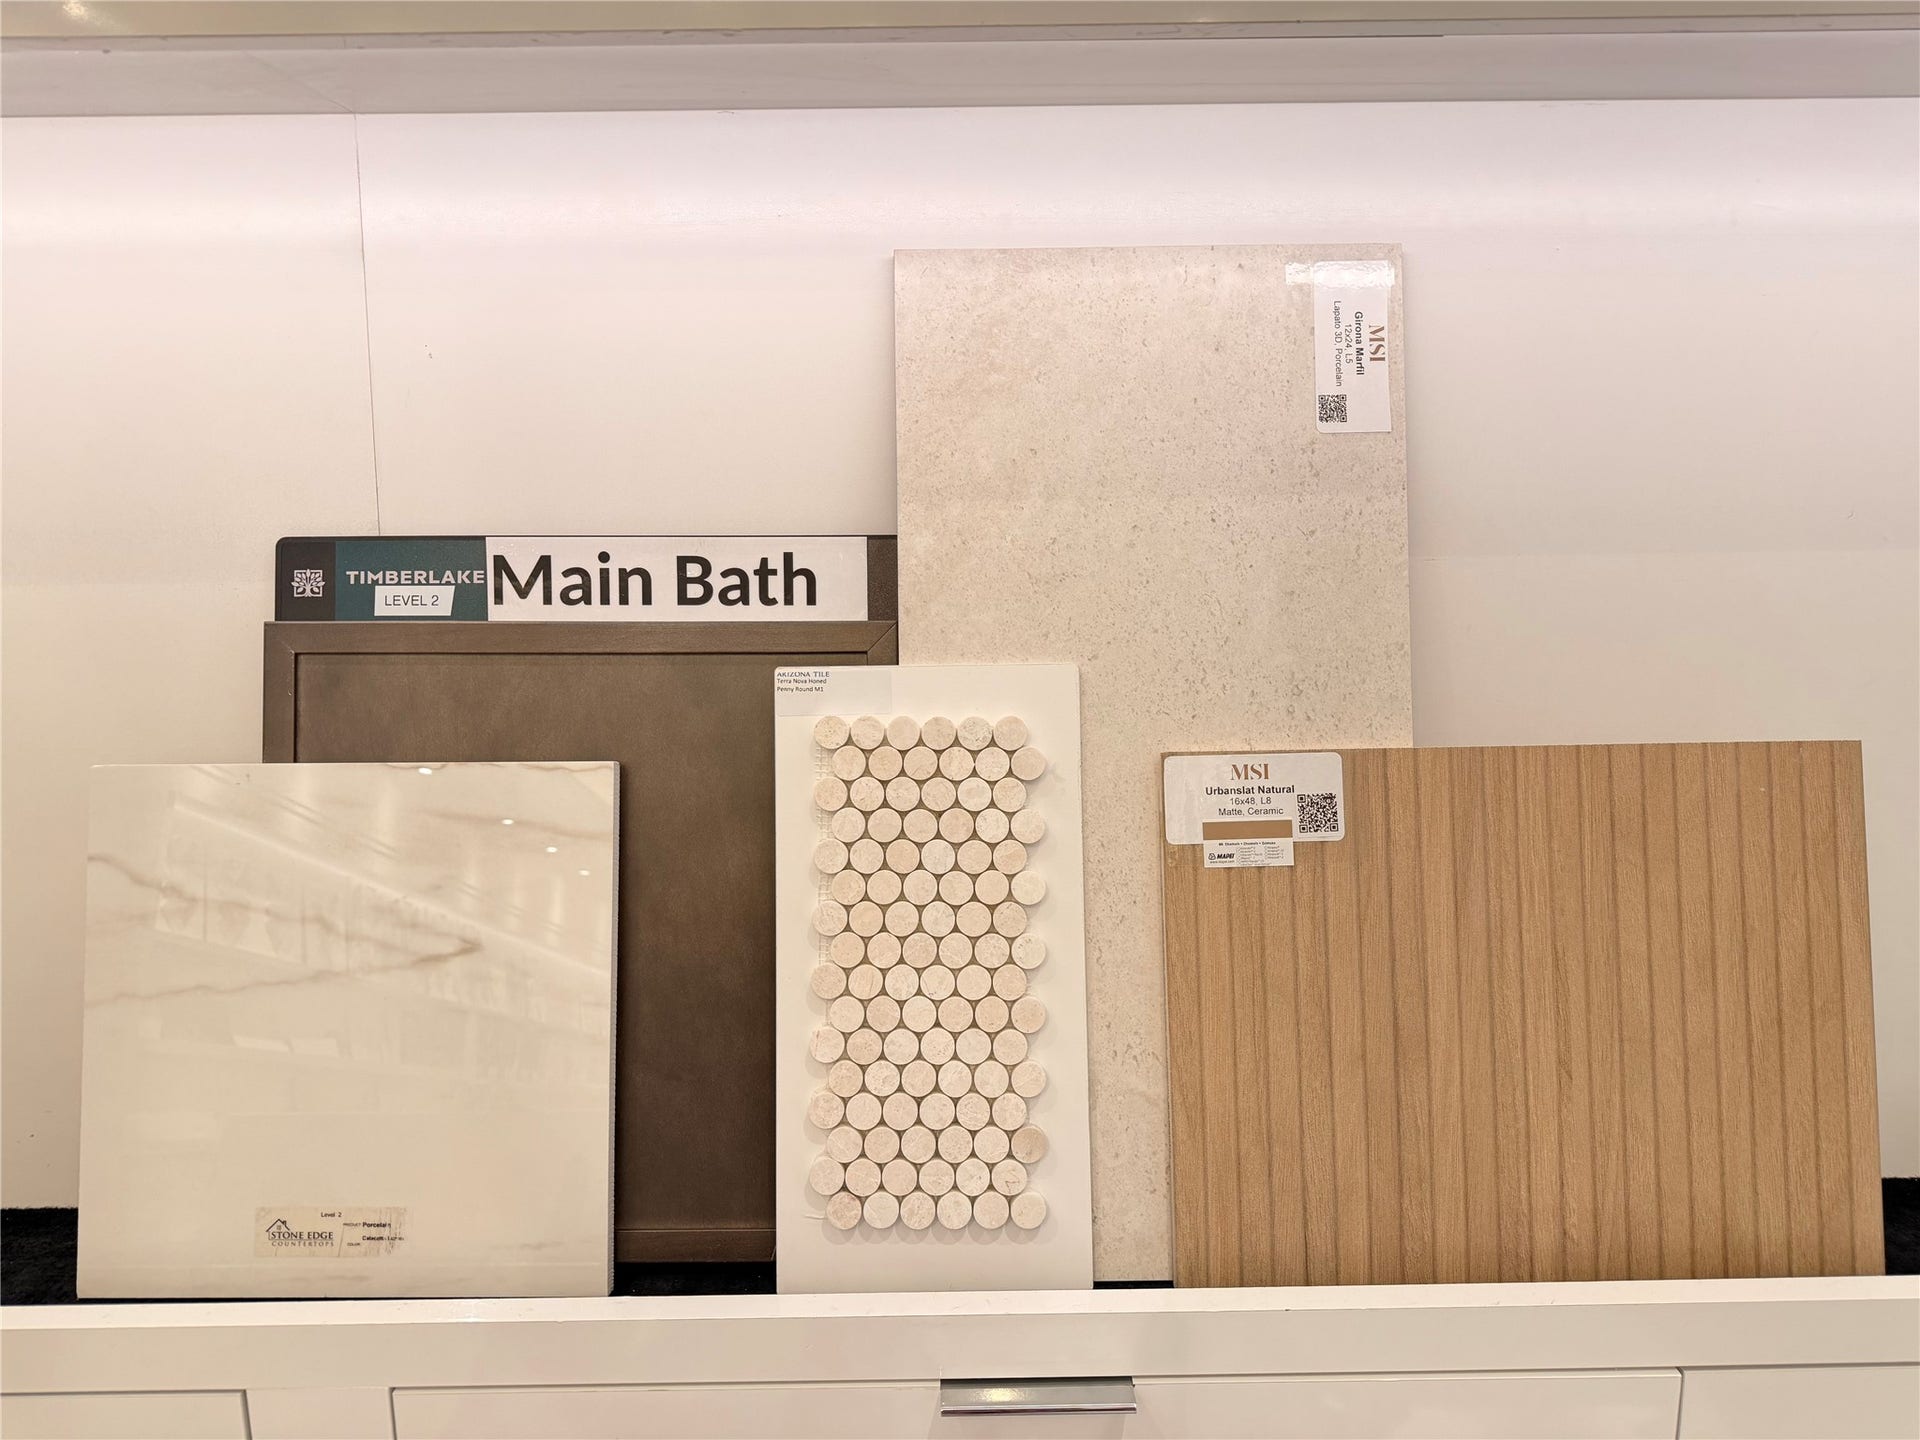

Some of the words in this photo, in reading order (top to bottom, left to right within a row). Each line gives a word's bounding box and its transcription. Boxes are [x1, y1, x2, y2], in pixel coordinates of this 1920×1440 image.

[1333, 301, 1341, 330] Lapato
[1354, 311, 1363, 345] Girona
[1334, 331, 1342, 345] 3D,
[1369, 325, 1385, 361] MSI
[1345, 353, 1353, 364] L5
[1356, 347, 1365, 375] Marfil
[346, 570, 485, 584] TIMBERLAKE
[493, 551, 653, 606] Main
[677, 551, 818, 606] Bath
[384, 595, 427, 606] LEVEL
[431, 595, 439, 606] 2
[1231, 763, 1270, 781] MSI
[1205, 786, 1255, 796] Urbanslat
[1258, 785, 1295, 794] Natural
[1230, 797, 1258, 806] 16x48,
[1261, 797, 1272, 805] L8
[1218, 808, 1245, 816] Matte,
[1248, 807, 1284, 815] Ceramic
[271, 1232, 304, 1240] STONE
[307, 1231, 334, 1240] EDGE
